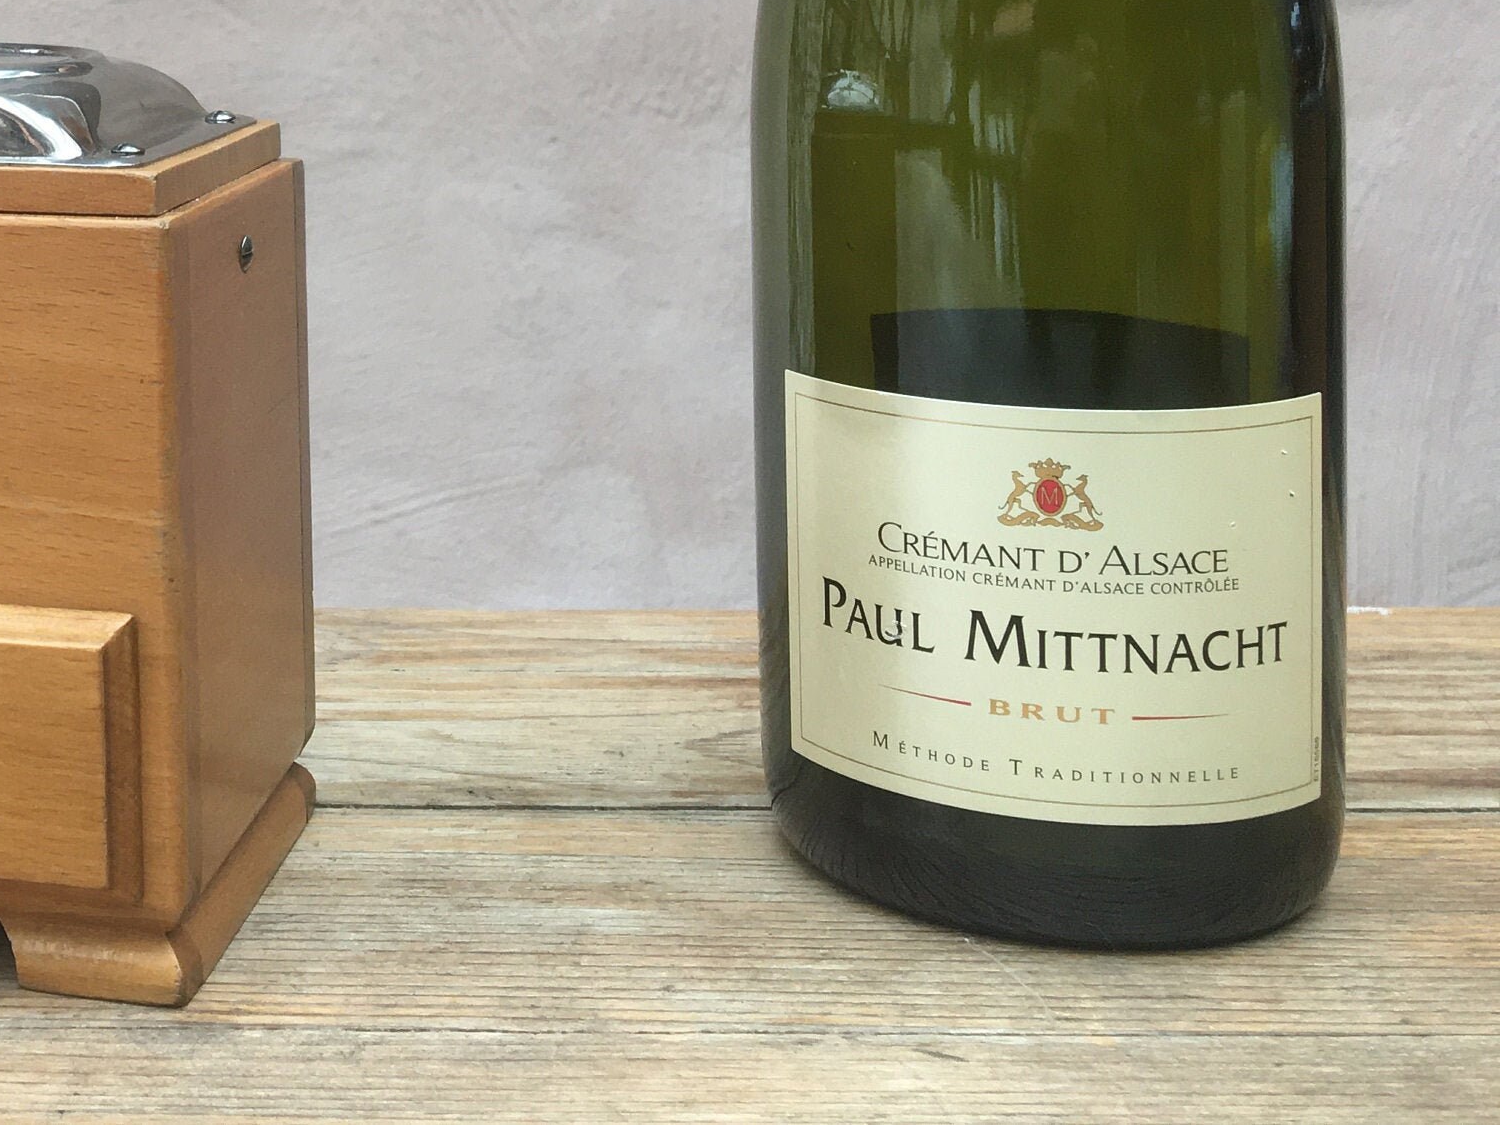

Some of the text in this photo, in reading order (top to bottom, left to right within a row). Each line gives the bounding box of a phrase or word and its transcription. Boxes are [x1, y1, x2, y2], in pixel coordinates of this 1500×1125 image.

[1040, 485, 1060, 506] M
[877, 521, 1045, 572] CRÉMANT
[1098, 545, 1229, 576] ALSACE
[868, 554, 1240, 595] APPELLATION CRÉMANT D'ALSACE CONTRÔLÉE
[821, 576, 1289, 675] PAUL MITTNACHT
[988, 698, 1116, 725] BRUT
[872, 730, 1240, 784] MÉTHODE TRADITIONNELLE
